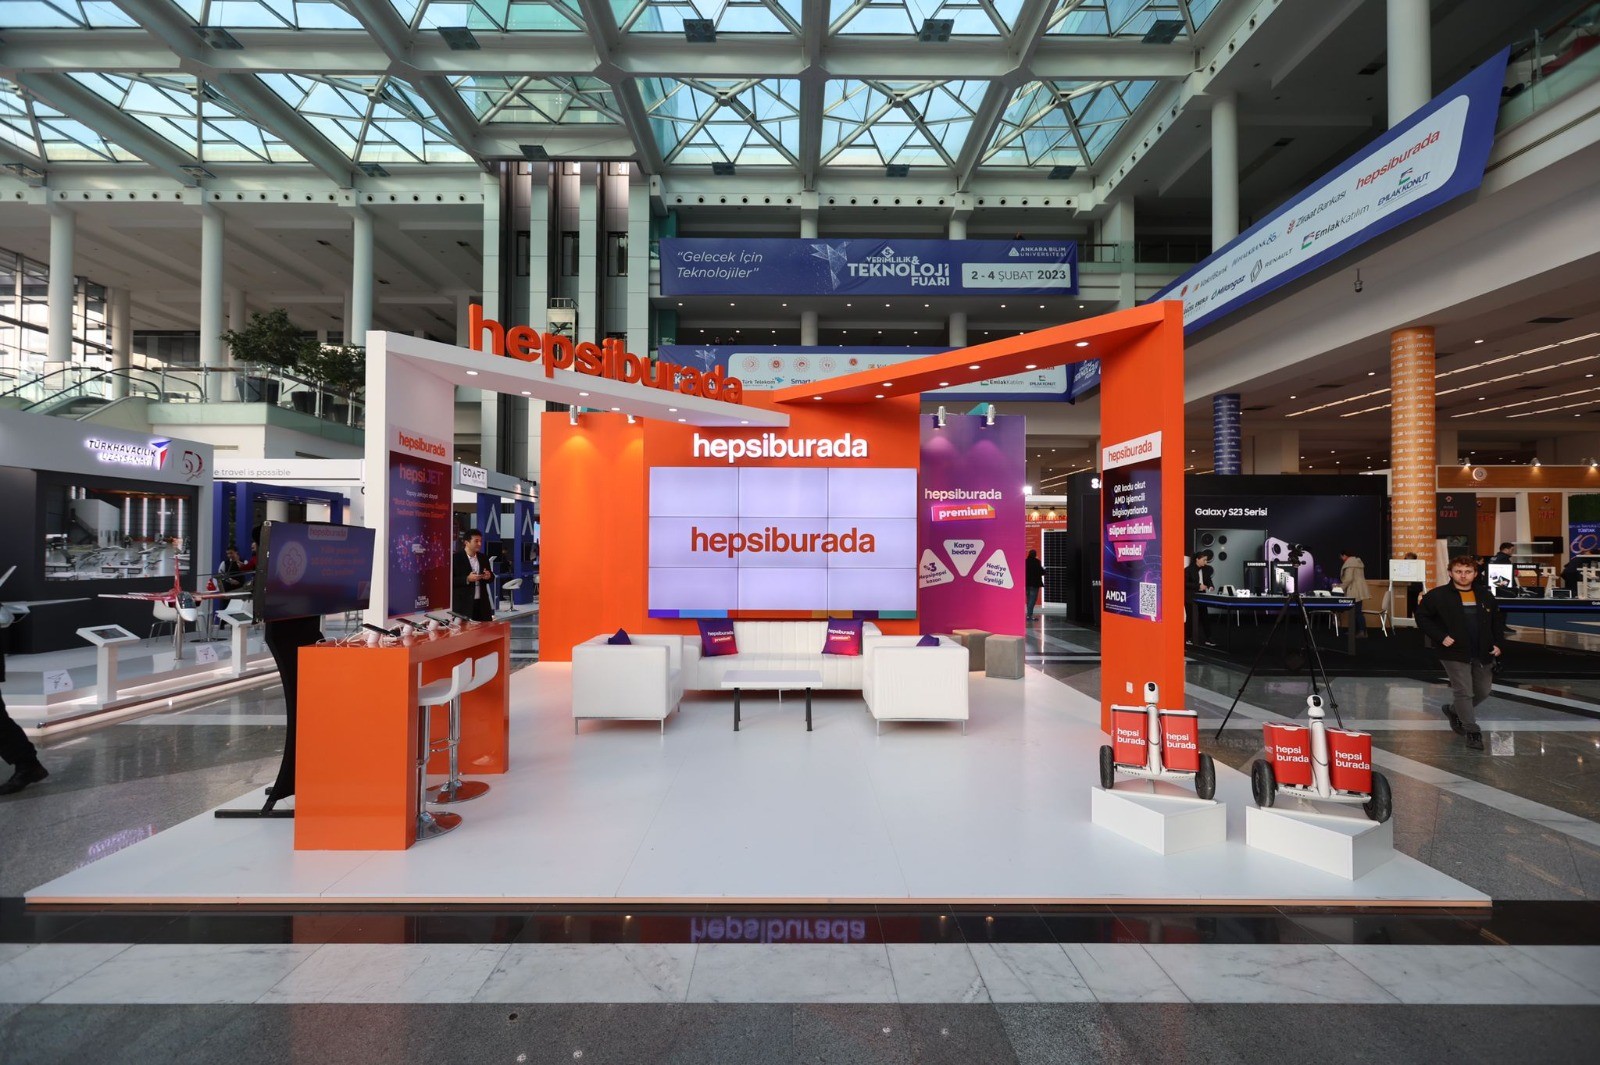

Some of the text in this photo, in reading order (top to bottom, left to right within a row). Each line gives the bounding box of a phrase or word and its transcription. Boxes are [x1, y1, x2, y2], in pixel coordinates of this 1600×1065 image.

[1356, 130, 1440, 190] hepsiburada
[1378, 171, 1432, 206] EMLAK KONUT
[1296, 207, 1318, 228] Ziraat
[740, 250, 763, 264] İçin
[1264, 248, 1293, 268] RENAULT
[848, 263, 950, 277] TEKNOLOJİ
[971, 271, 979, 280] 2
[987, 271, 995, 280] 4
[998, 271, 1034, 282] ŞUBAT
[1037, 270, 1066, 280] 2023
[912, 277, 950, 286] FUARI
[469, 304, 742, 404] hepsiburada
[398, 432, 446, 457] hepsiburada
[693, 433, 868, 463] hepsiburada
[1108, 440, 1152, 463] hepsiburada
[256, 468, 291, 477] possible
[1114, 481, 1146, 493] QR kodu okut
[924, 488, 1002, 501] hepsiburada
[1114, 496, 1125, 504] AMD
[939, 507, 988, 520] premium
[1112, 506, 1148, 518] bilgisayarlarda
[1195, 508, 1227, 517] Galaxy
[1244, 508, 1268, 516] Serisi
[1109, 522, 1152, 537] süper indirimi
[692, 527, 875, 558] hepsiburada
[1118, 544, 1142, 557] yakala!
[986, 563, 1006, 572] Hediye
[1106, 590, 1120, 602] AMD
[1117, 728, 1139, 737] hepsi
[1166, 732, 1189, 741] hepsi
[1117, 736, 1145, 745] burada
[1166, 740, 1196, 749] burada
[1276, 745, 1301, 754] hepsi
[1335, 750, 1362, 760] hepsi
[1276, 754, 1309, 763] burada
[1336, 759, 1370, 770] burada
